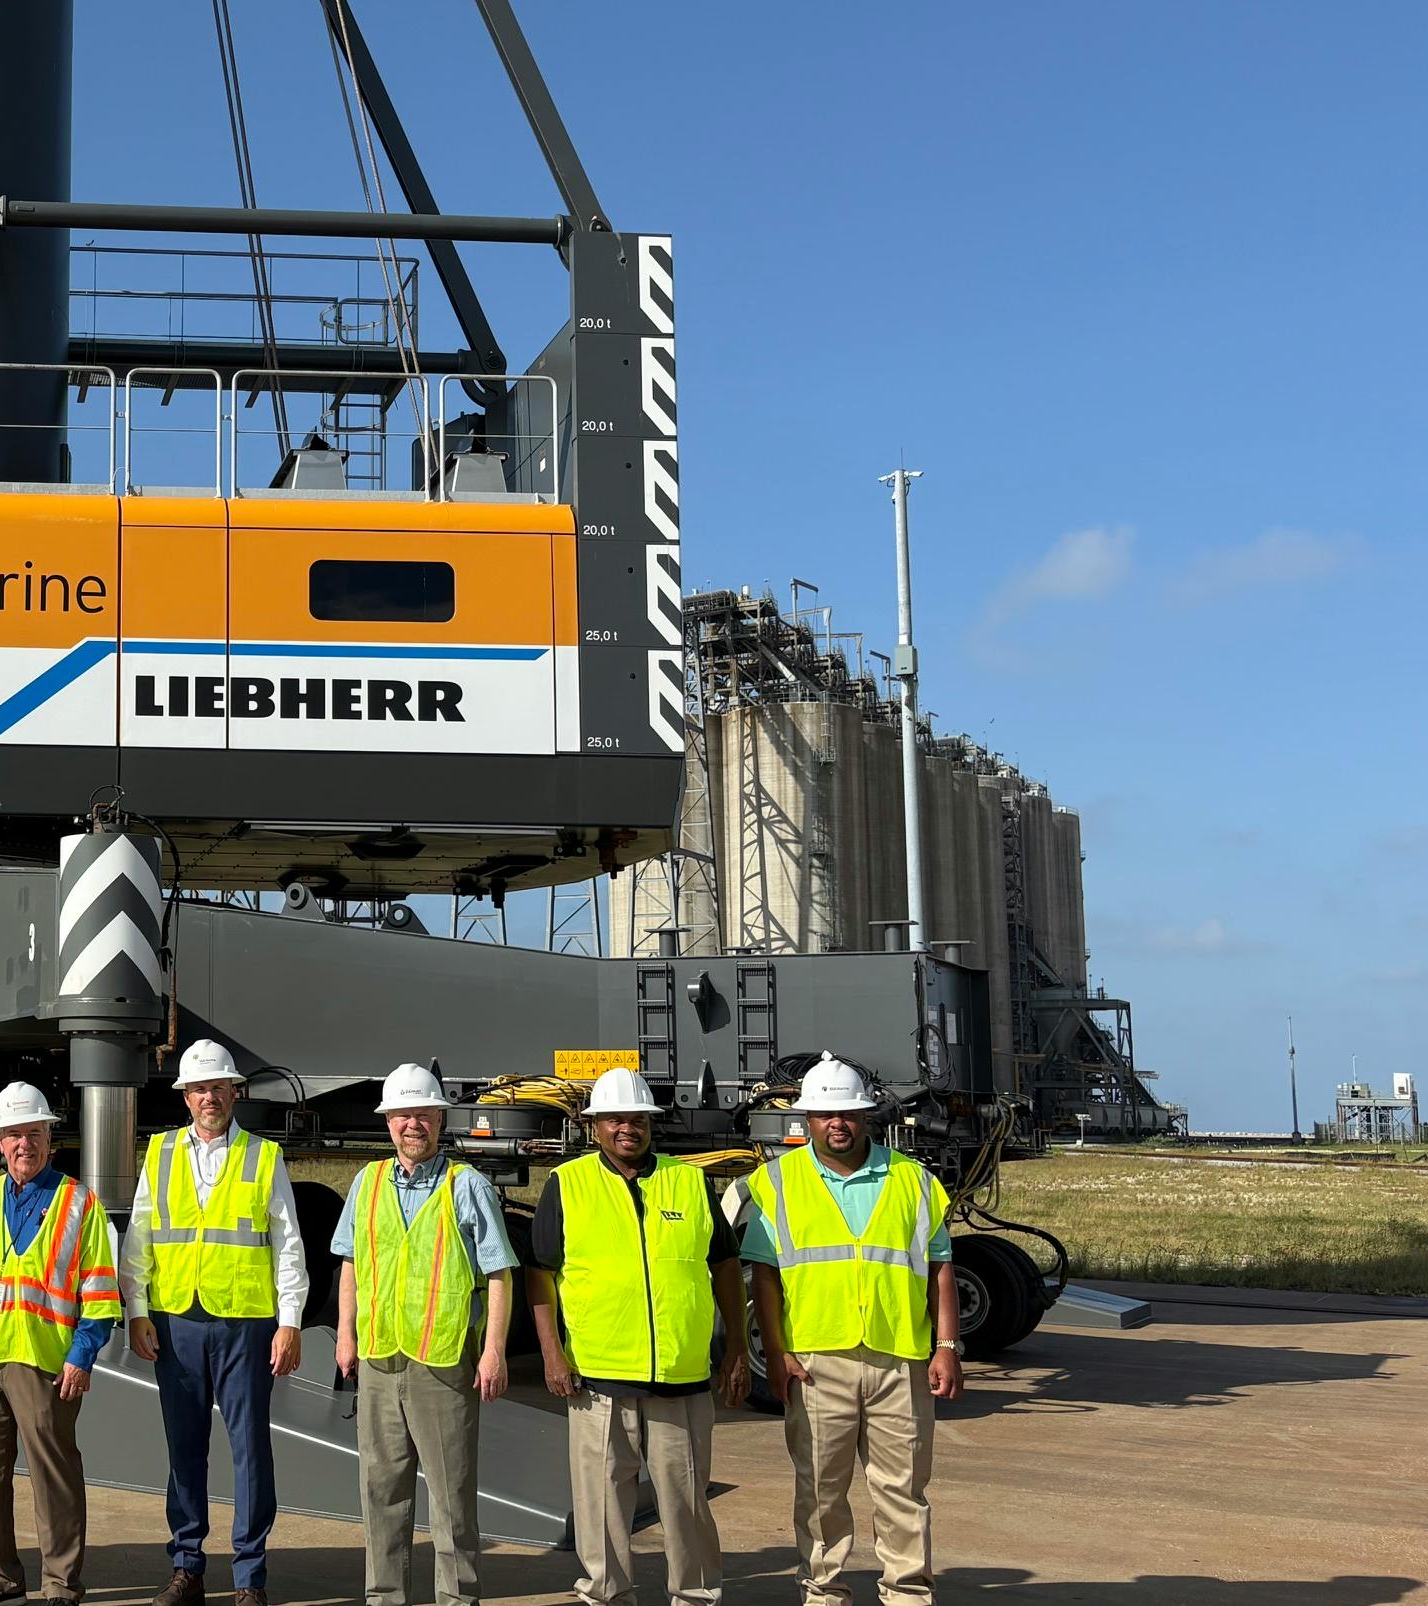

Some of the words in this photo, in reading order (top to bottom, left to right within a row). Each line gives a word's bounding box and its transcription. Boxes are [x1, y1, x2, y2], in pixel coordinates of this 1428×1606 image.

[579, 317, 604, 329] 20,0
[606, 318, 611, 329] t
[581, 420, 607, 432] 20,0
[609, 421, 614, 432] t
[583, 525, 608, 537] 20,0
[610, 526, 615, 536] t
[585, 630, 611, 642] 25,0
[613, 631, 618, 641] t
[134, 675, 466, 722] LIEBHERR
[587, 737, 612, 749] 25,0
[615, 738, 620, 748] t
[28, 922, 35, 962] 3
